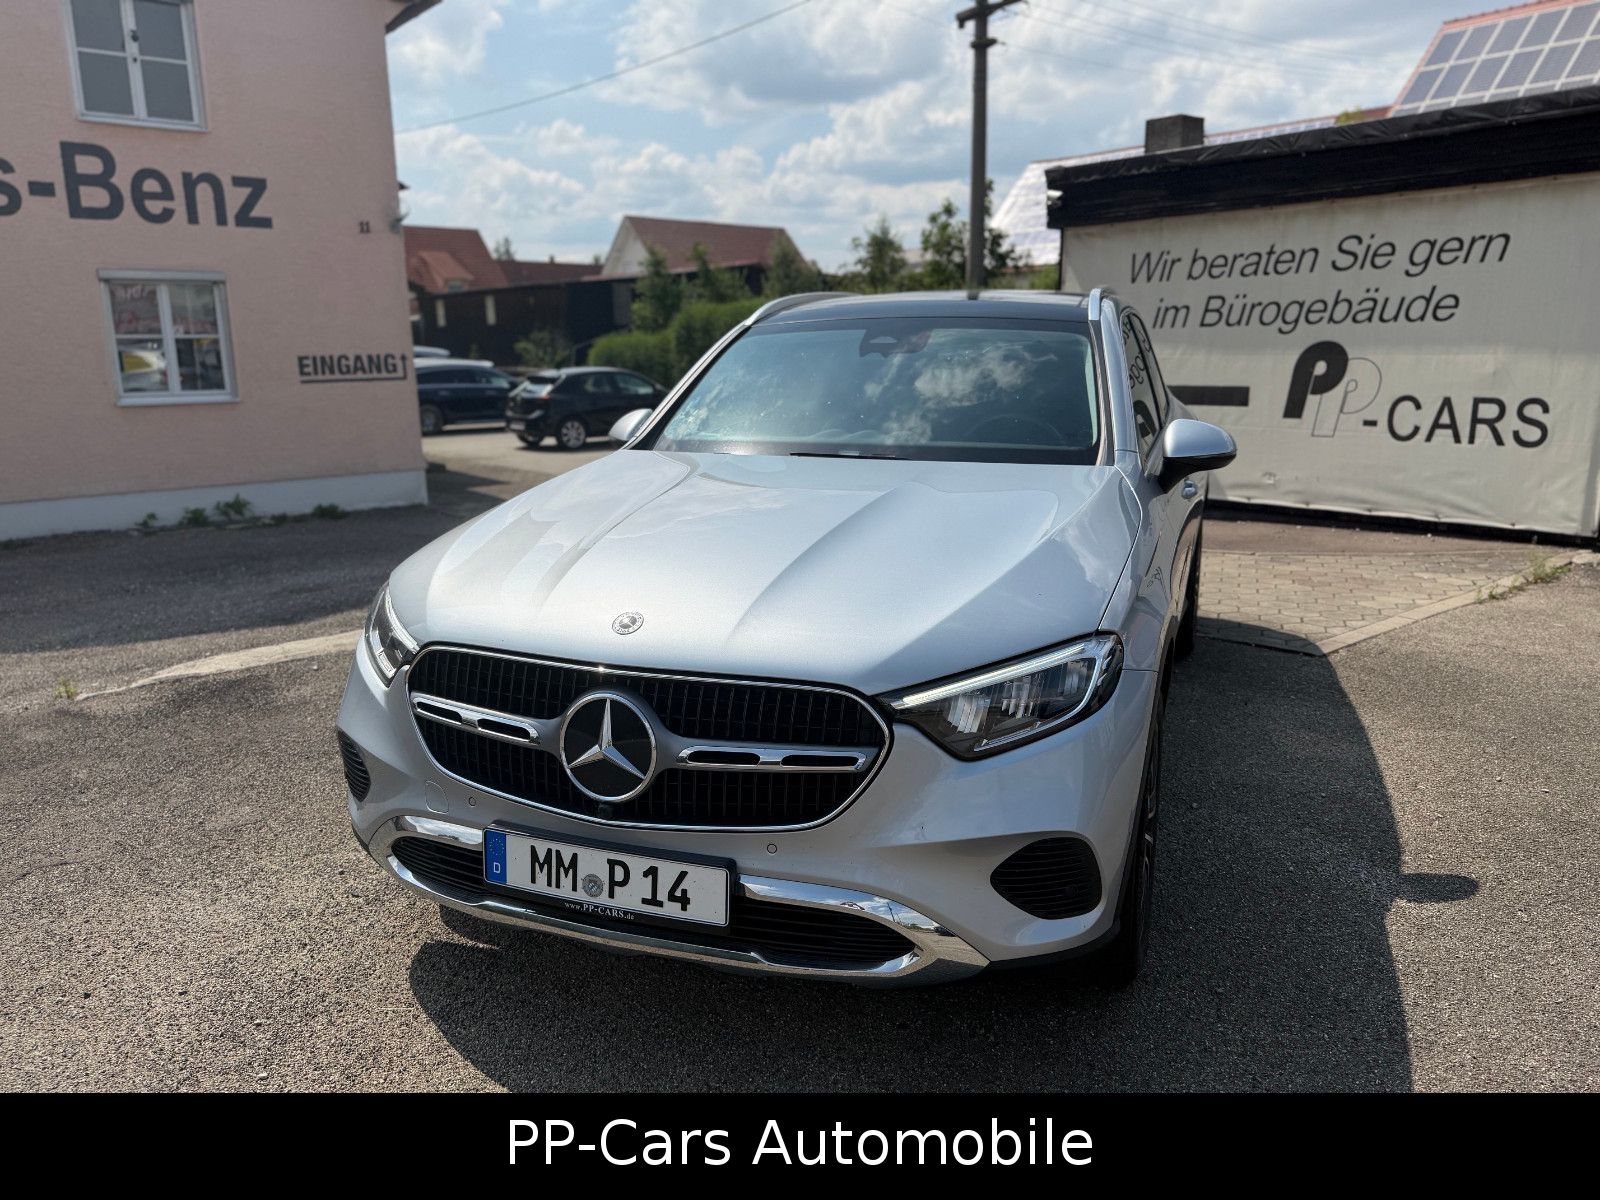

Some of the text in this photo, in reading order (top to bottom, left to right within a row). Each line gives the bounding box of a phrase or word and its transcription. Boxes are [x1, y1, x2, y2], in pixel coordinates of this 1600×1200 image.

[1130, 231, 1511, 284] Wir beraten Sie gern
[1152, 286, 1460, 335] im Bürogebäude
[297, 353, 399, 377] EINGANG
[493, 862, 501, 874] D
[530, 845, 578, 892] MM
[607, 858, 631, 899] P
[641, 865, 691, 912] 14
[564, 902, 635, 920] www.PP-CARS.de
